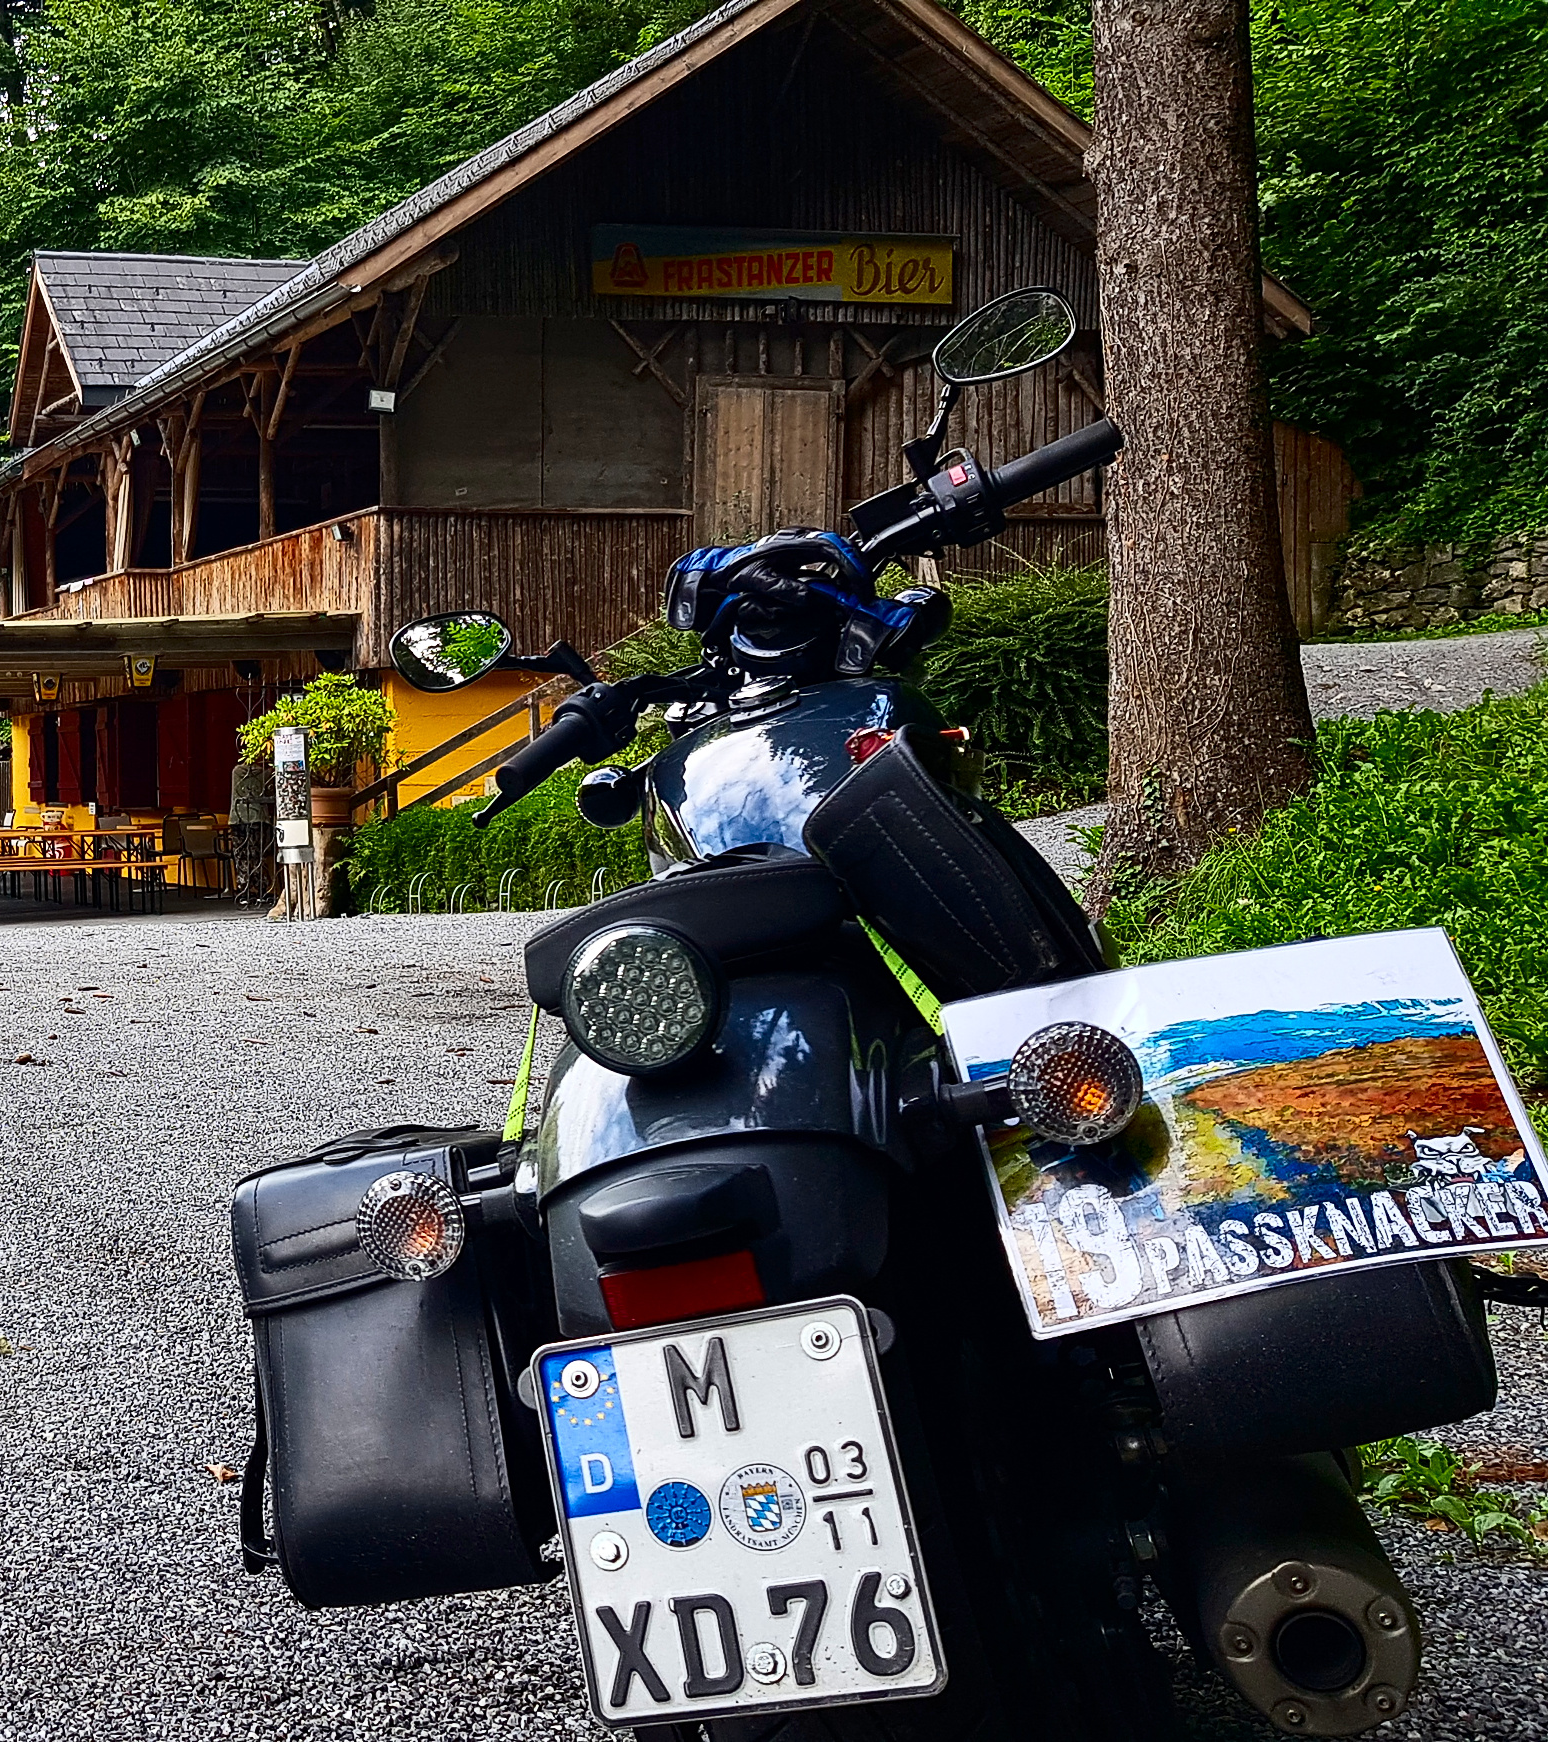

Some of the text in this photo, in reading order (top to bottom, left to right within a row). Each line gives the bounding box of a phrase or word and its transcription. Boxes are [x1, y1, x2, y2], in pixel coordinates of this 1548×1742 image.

[662, 243, 945, 296] FRASTANZER Bier
[1014, 1184, 1144, 1318] 19
[1145, 1180, 1548, 1295] PASSKNACKER
[663, 1336, 741, 1439] M
[579, 1452, 614, 1495] D
[736, 1467, 774, 1480] BAYERN
[804, 1441, 869, 1486] 03
[822, 1506, 879, 1551] 11
[595, 1571, 916, 1708] XD 76
